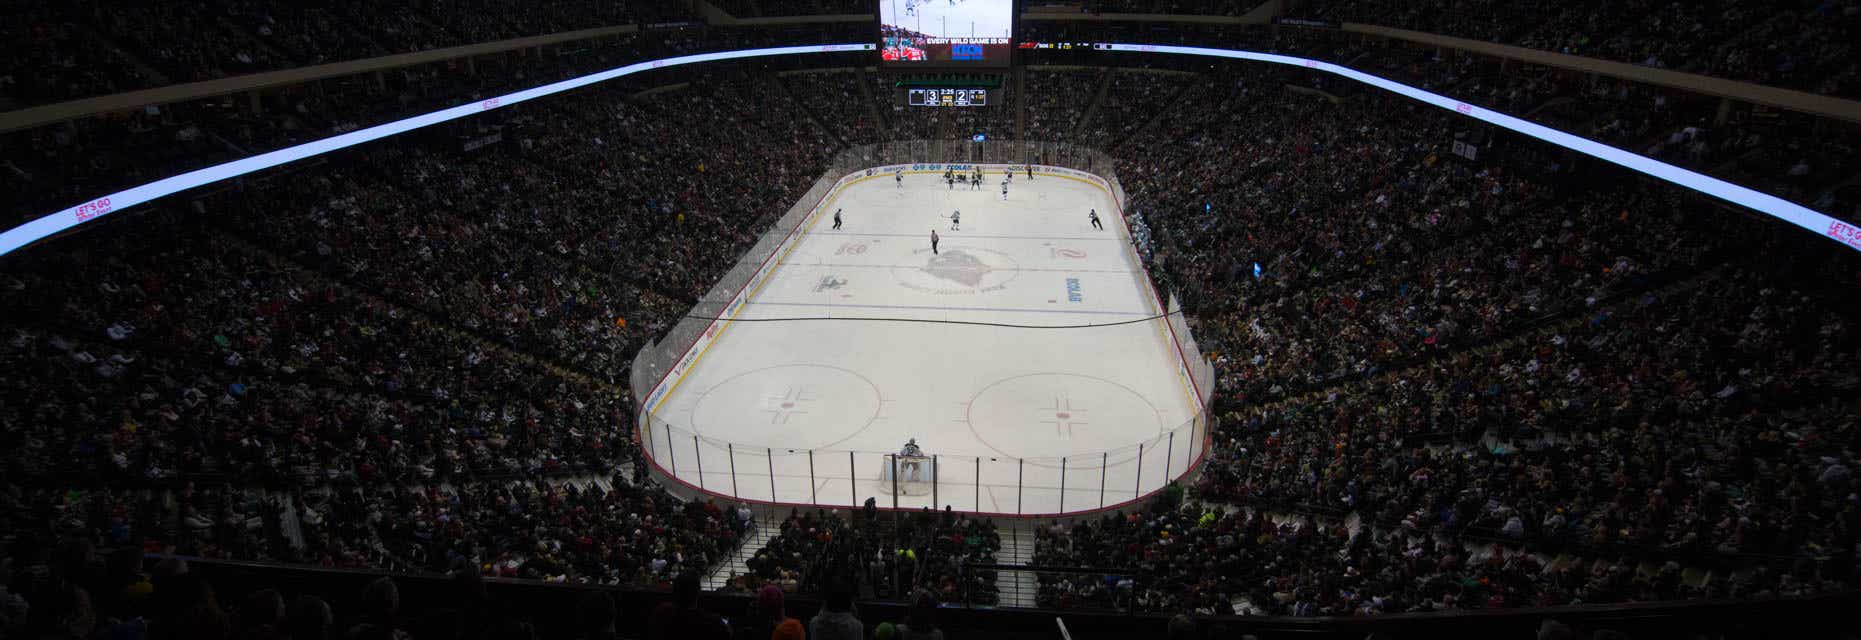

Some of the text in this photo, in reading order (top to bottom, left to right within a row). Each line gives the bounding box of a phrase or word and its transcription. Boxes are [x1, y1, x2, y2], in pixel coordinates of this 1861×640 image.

[929, 91, 936, 100] 3
[958, 91, 965, 101] 2
[75, 198, 111, 216] LET'S GO
[1830, 220, 1855, 236] LET'S
